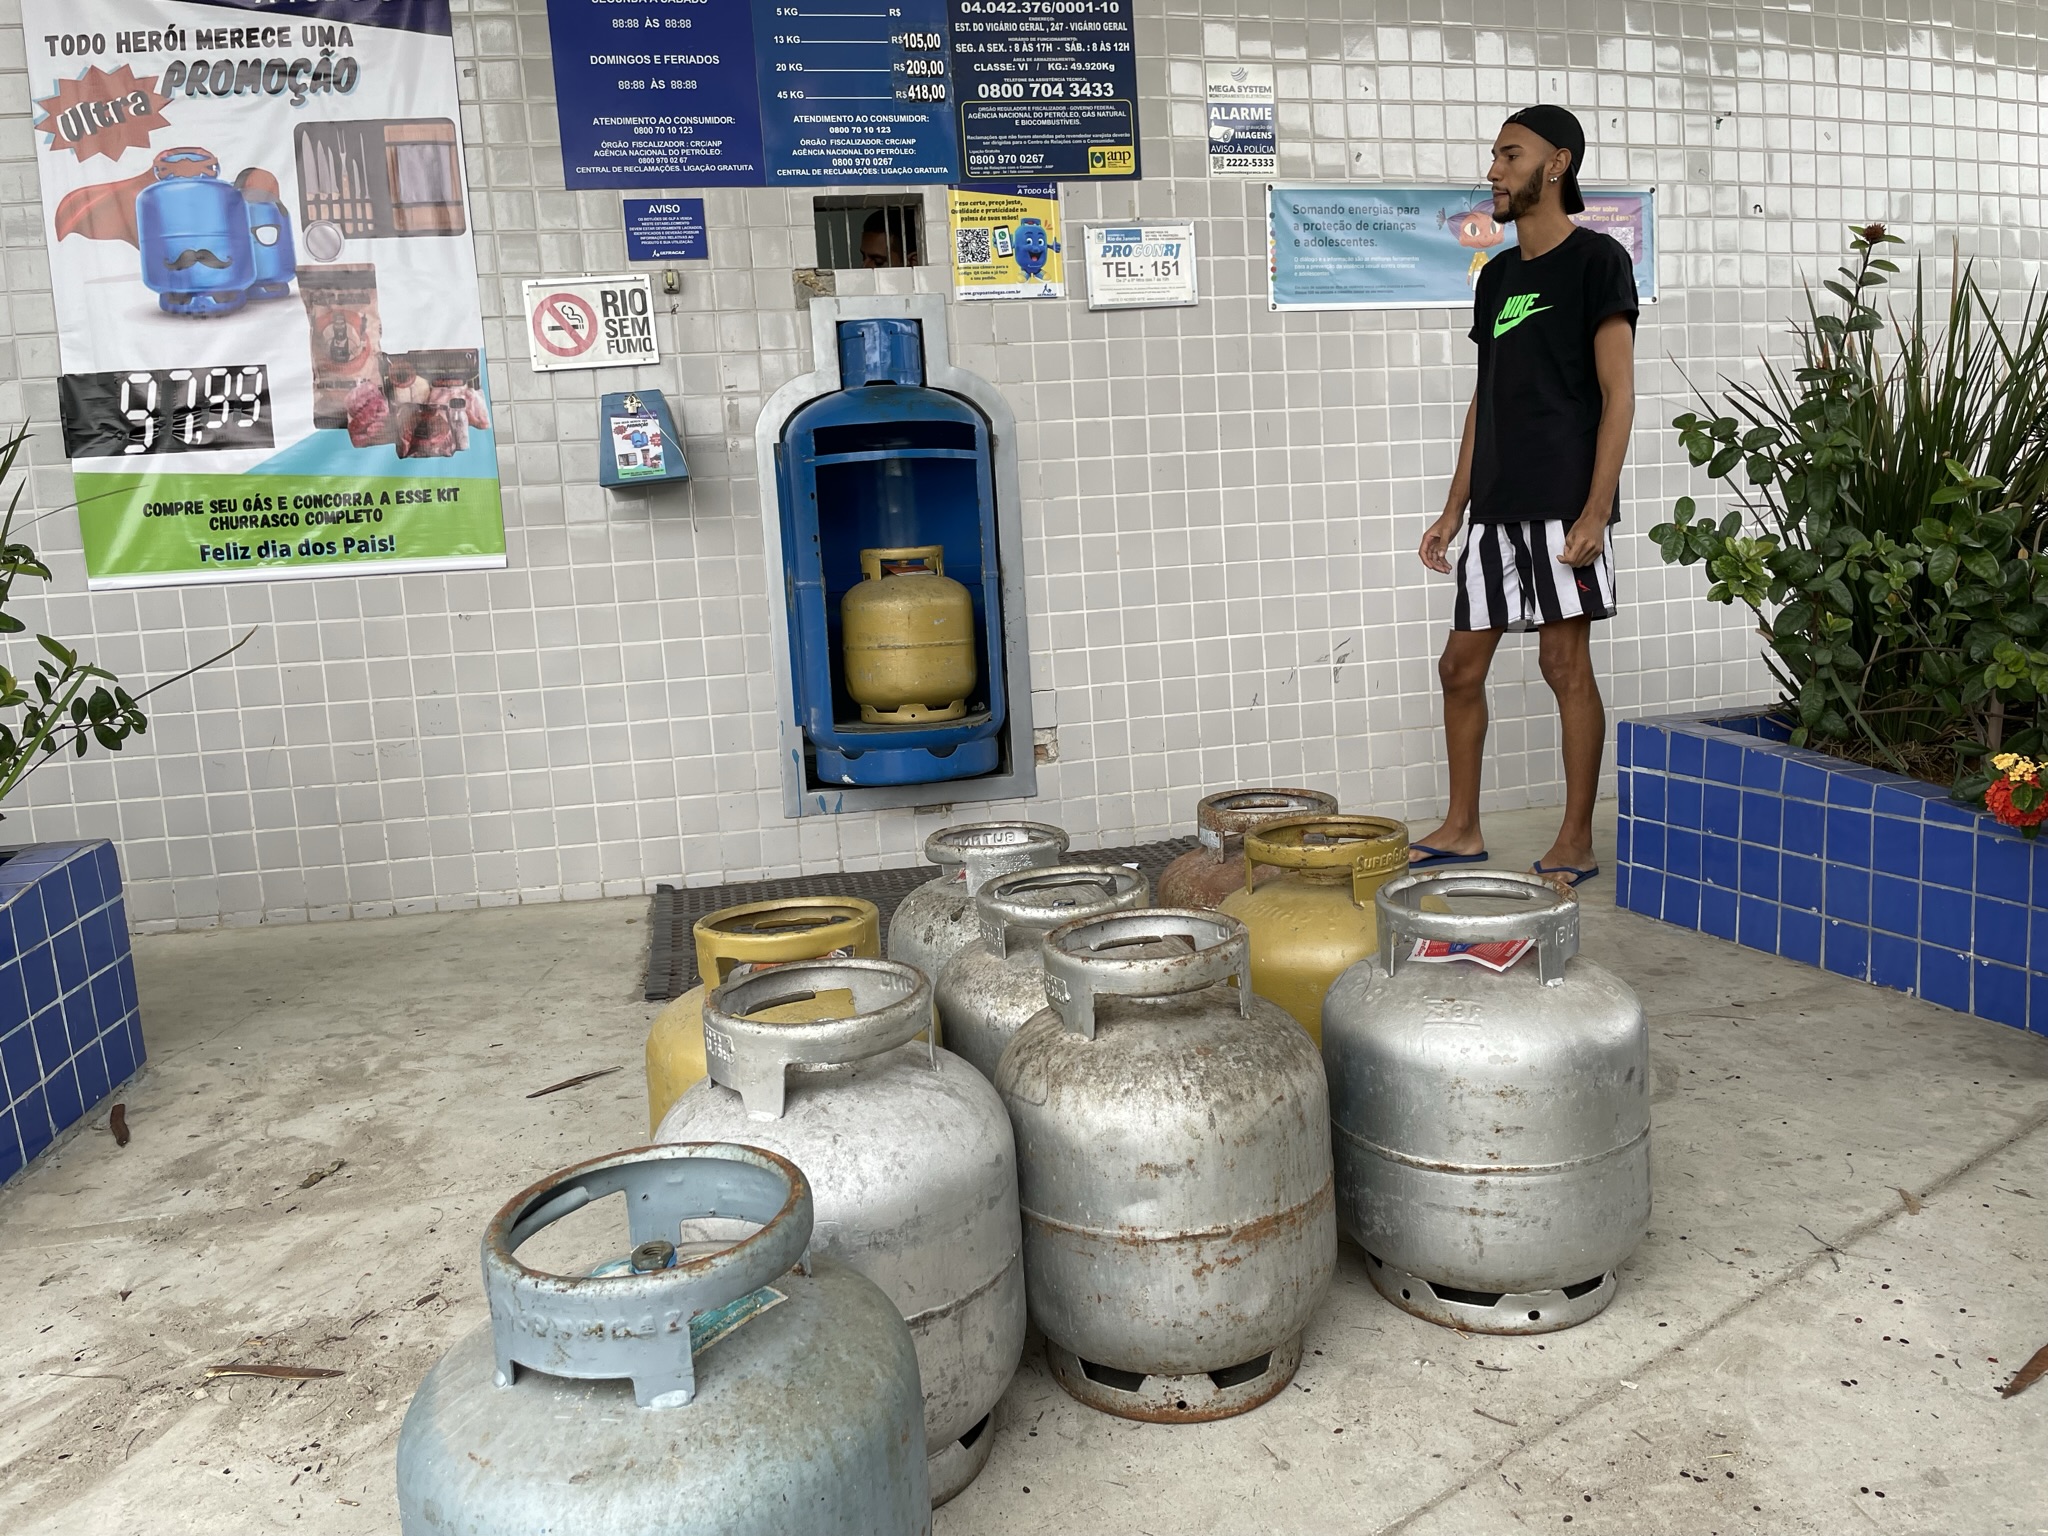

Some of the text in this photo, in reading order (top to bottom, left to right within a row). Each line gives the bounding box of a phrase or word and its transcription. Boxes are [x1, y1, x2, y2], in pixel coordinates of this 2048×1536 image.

[776, 8, 901, 17] 5 KG R$
[961, 2, 1120, 14] 04.042.376/0001-10
[612, 16, 692, 28] 88:88 ÀS 88:88
[955, 22, 970, 32] EST.
[973, 22, 984, 32] DO
[985, 20, 1018, 32] VIGÁRIO
[1020, 22, 1044, 32] GERAL
[1050, 22, 1064, 31] 247
[1070, 20, 1100, 31] VIGÁRIO
[1102, 22, 1128, 31] GERAL
[45, 24, 353, 57] TODO HERÓI MERECE UMA
[786, 36, 800, 44] KG
[892, 36, 903, 44] R$
[903, 33, 940, 50] 105,00
[956, 44, 976, 52] SEG.
[978, 44, 986, 52] A
[986, 44, 1008, 52] SEX.
[1014, 44, 1020, 52] 8
[1022, 40, 1034, 52] ÀS
[1036, 43, 1052, 52] 17H
[1065, 41, 1086, 52] SÁB.
[1092, 43, 1098, 51] 8
[1099, 40, 1112, 51] ÀS
[1113, 42, 1130, 51] 12H
[590, 55, 720, 64] DOMINGOS E FERIADOS
[788, 64, 802, 72] KG
[894, 64, 905, 72] R$
[906, 60, 944, 77] 209,00
[974, 64, 1016, 72] CLASSE:
[1018, 63, 1028, 71] VI
[1048, 63, 1068, 71] KG.:
[1070, 62, 1116, 72] 49.920Kg
[163, 48, 360, 106] PROMOÇÃO
[618, 77, 698, 90] 88:88 ÀS 88:88
[896, 91, 907, 99] R$
[908, 84, 945, 102] 418,00
[978, 82, 1114, 98] 0800 704 3433
[58, 87, 151, 143] Ultra
[968, 110, 998, 119] AGÊNCIA
[1044, 109, 1080, 118] PETRÓLEO,
[1082, 109, 1096, 118] GÁS
[1210, 106, 1272, 120] ALARME
[593, 117, 656, 126] ATENDIMENTO
[674, 116, 736, 124] CONSUMIDOR:
[634, 126, 694, 134] 0800 70 10 123
[1210, 144, 1274, 153] AVISO À POLÍCIA
[832, 158, 852, 166] 0800
[872, 158, 893, 166] 0267
[970, 154, 1044, 164] 0800 970 0267
[1107, 150, 1131, 164] anp
[1226, 158, 1274, 167] 2222-5333
[881, 166, 912, 175] LIGAÇÃO
[649, 204, 680, 214] AVISO
[1292, 204, 1420, 218] Somando energias para
[1294, 219, 1416, 232] a proteção de crianças
[1294, 236, 1378, 248] e adolescentes.
[1102, 244, 1181, 259] PROCONRJ
[1102, 261, 1178, 278] TEL: 151
[600, 288, 648, 317] RIO
[1500, 293, 1540, 320] NIKE
[604, 316, 651, 338] SEM
[606, 338, 652, 354] FUMO
[143, 487, 460, 518] COMPRE SEU GÁS E CONCORRA A ESSE KIT
[209, 508, 383, 531] CHURRASCO COMPLETO
[200, 534, 396, 563] Feliz dia dos Pais!
